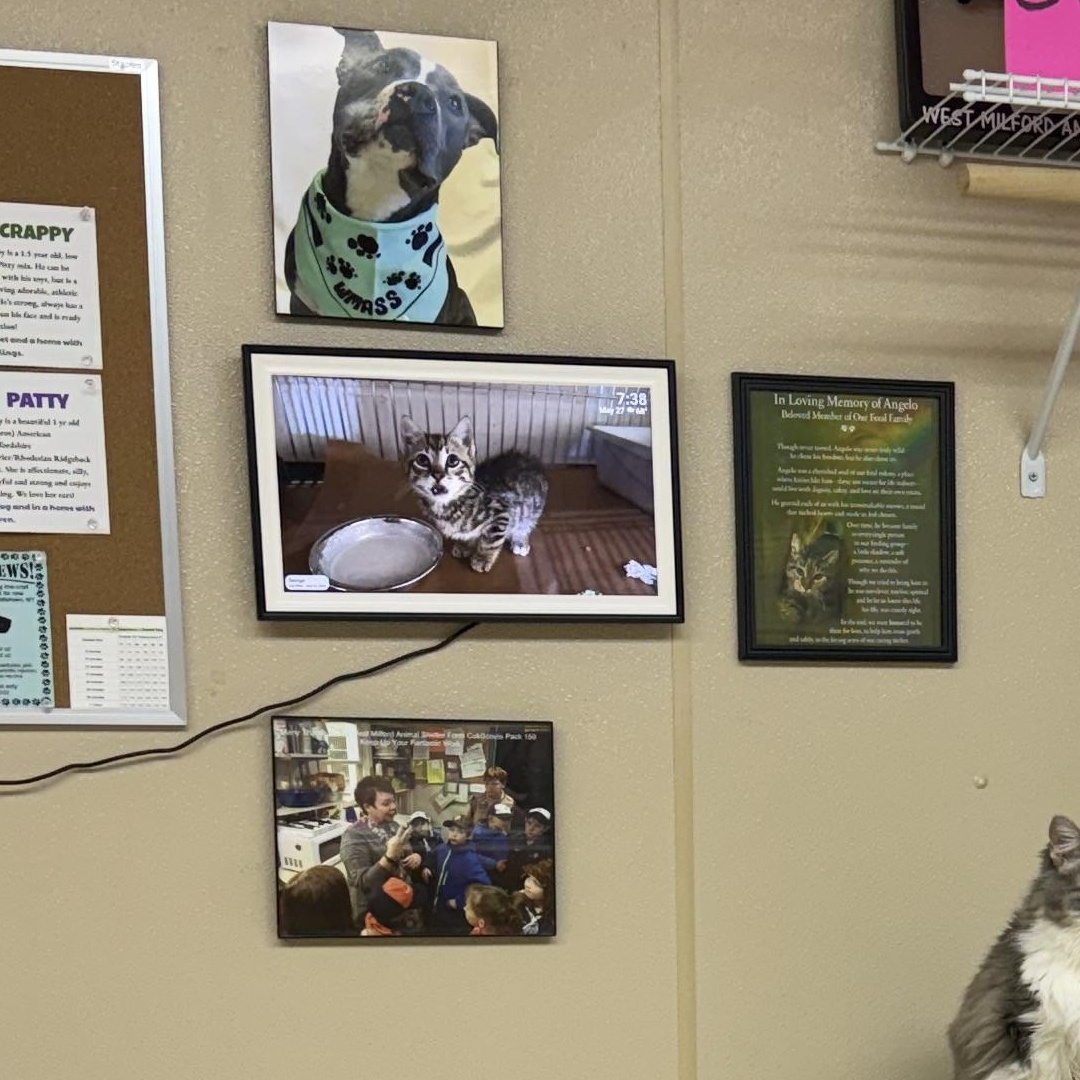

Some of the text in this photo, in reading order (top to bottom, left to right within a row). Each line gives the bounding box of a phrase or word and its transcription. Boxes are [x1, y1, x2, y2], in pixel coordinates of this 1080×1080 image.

[922, 105, 974, 127] WEST
[980, 110, 1054, 136] MILFORD
[7, 392, 69, 409] PATTY
[615, 391, 647, 406] 7:38
[773, 392, 919, 413] In Loving Memory of Angelo
[781, 409, 811, 420] Beloved
[811, 411, 842, 421] Member
[852, 412, 868, 422] Our
[888, 414, 913, 426] Family
